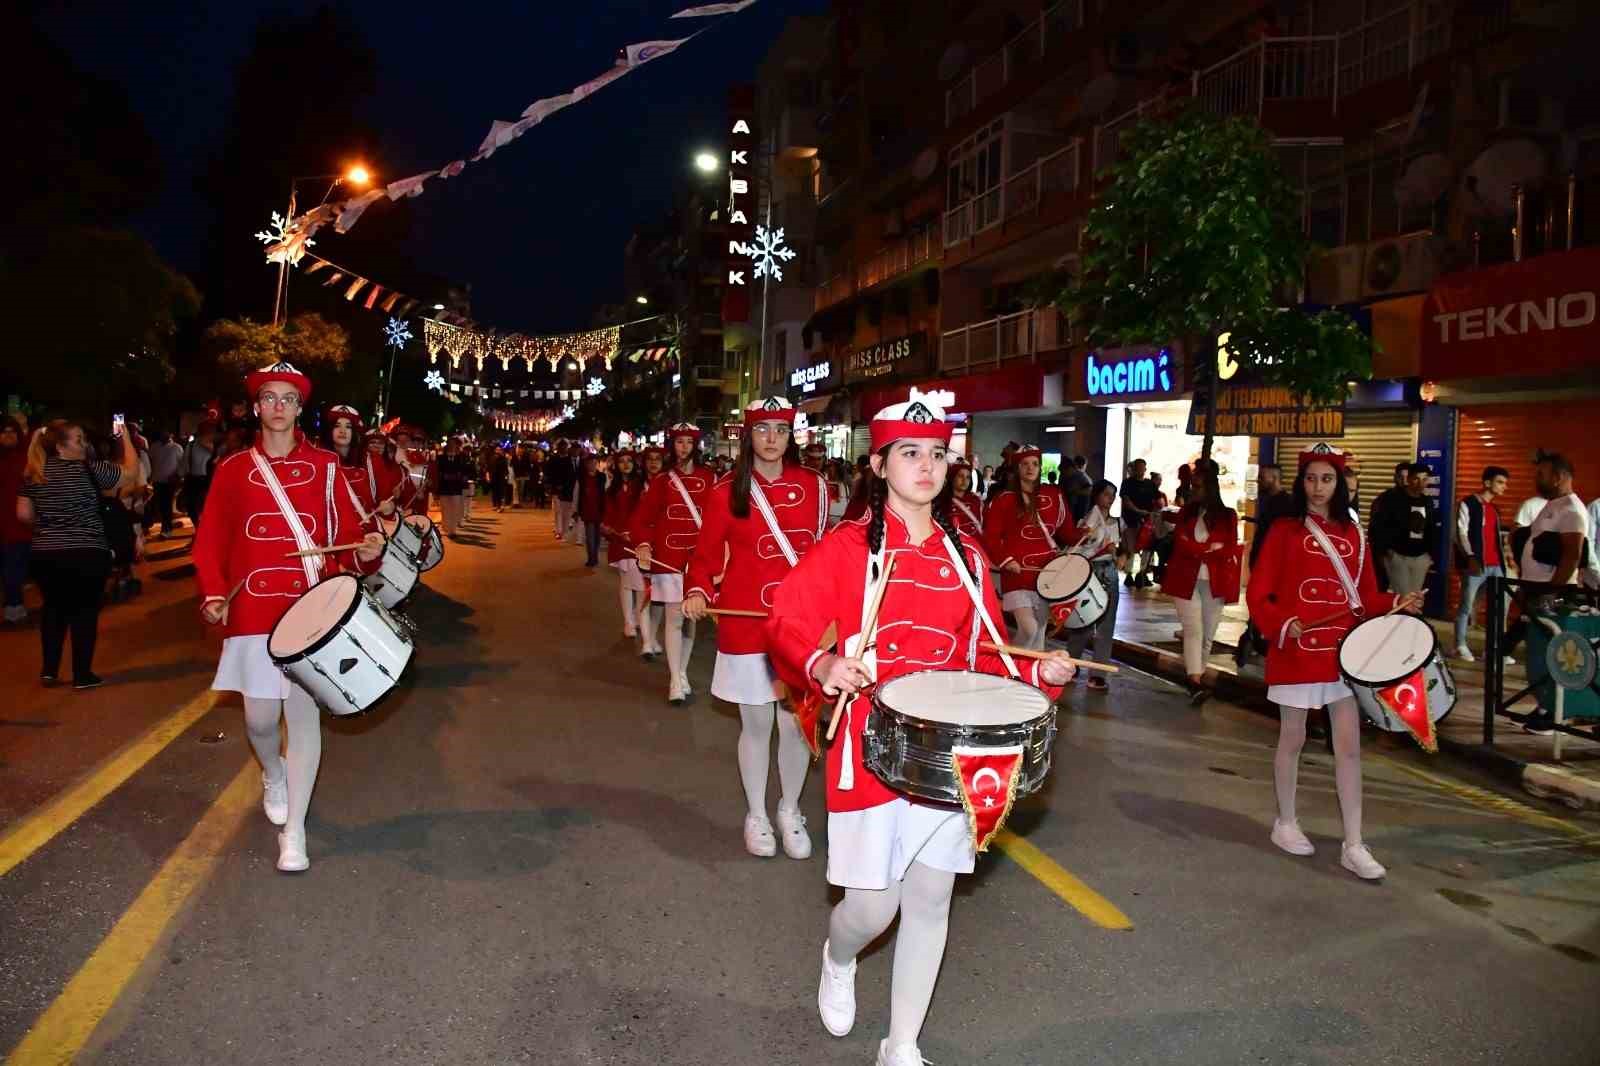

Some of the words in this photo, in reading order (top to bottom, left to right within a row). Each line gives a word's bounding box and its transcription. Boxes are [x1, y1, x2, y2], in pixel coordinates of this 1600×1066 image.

[728, 119, 750, 286] AKBANK
[1431, 290, 1597, 344] TEKNO
[807, 361, 830, 382] CLASS
[873, 338, 911, 366] CLASS
